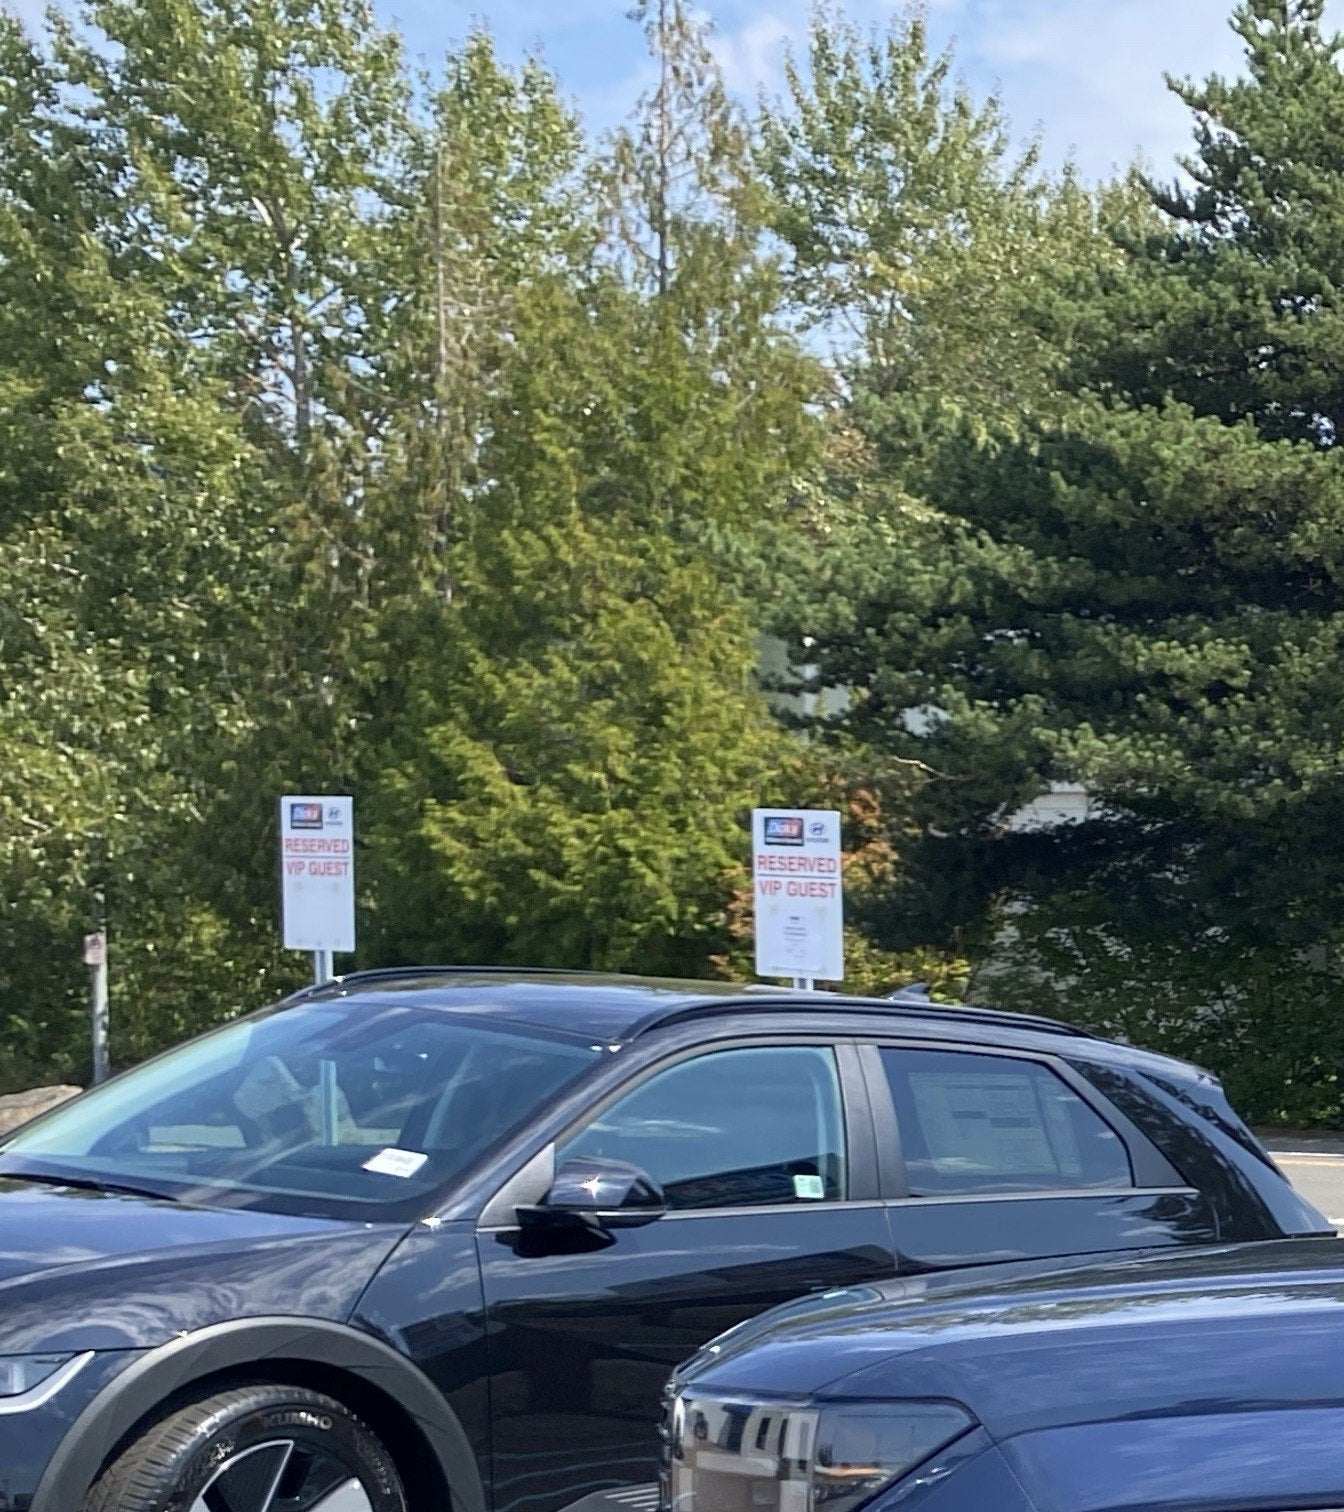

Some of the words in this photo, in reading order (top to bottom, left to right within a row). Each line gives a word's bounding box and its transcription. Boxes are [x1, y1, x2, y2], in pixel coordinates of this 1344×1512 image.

[285, 837, 350, 854] RESERVED
[286, 861, 305, 875] VIP
[309, 861, 350, 876] GUEST
[757, 855, 837, 873] RESERVED
[759, 881, 782, 896] VIP
[787, 882, 838, 899] GUEST
